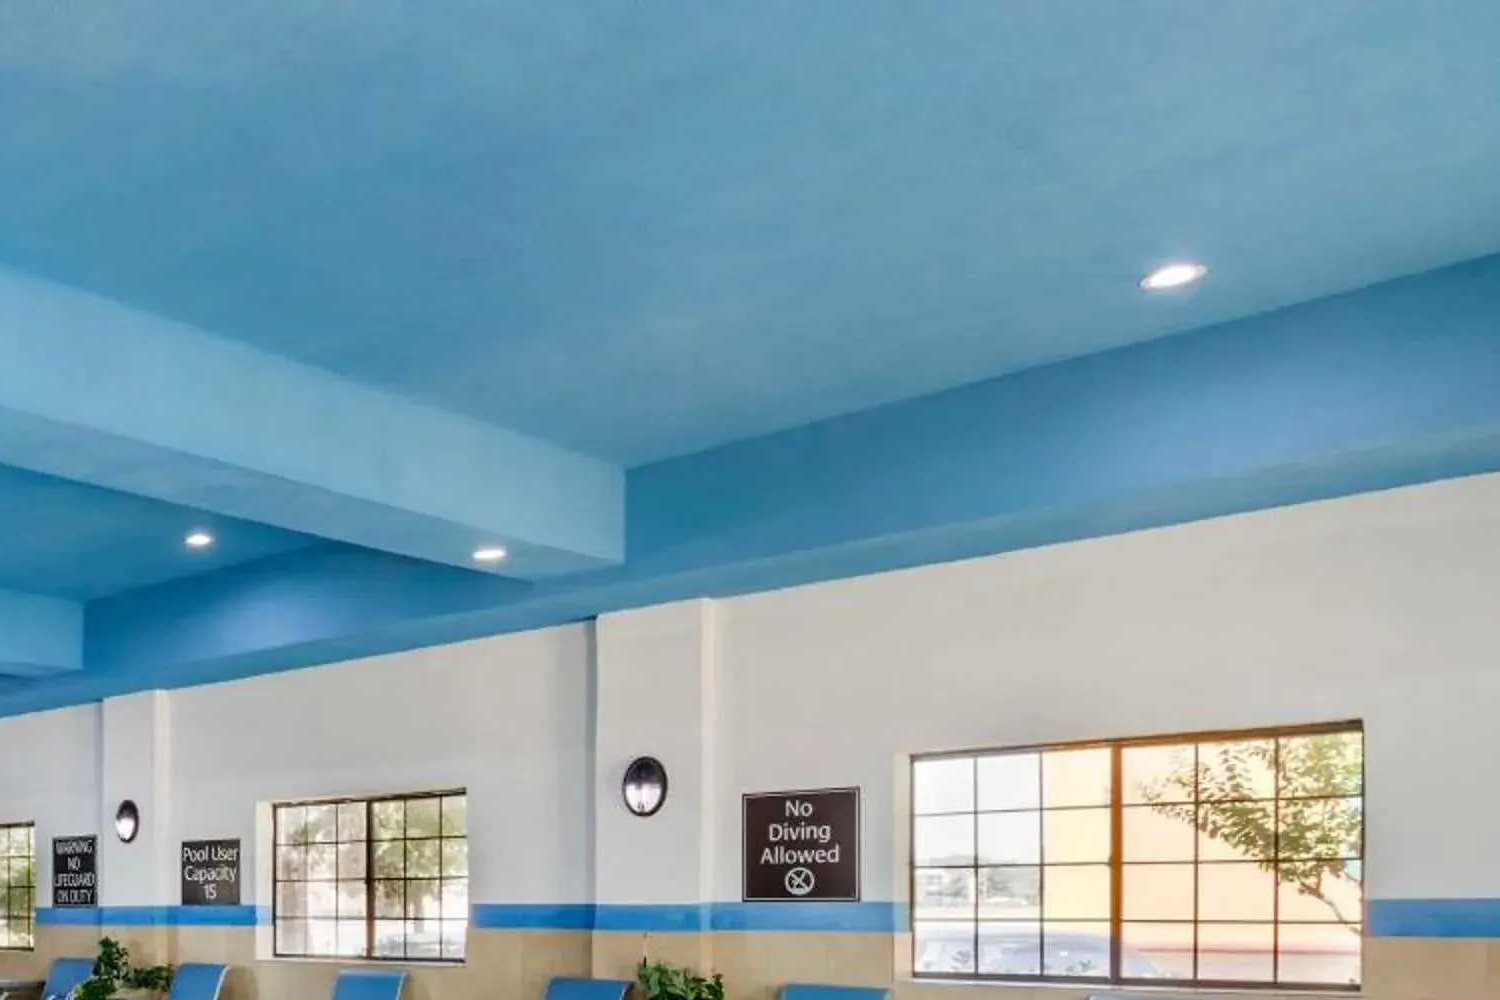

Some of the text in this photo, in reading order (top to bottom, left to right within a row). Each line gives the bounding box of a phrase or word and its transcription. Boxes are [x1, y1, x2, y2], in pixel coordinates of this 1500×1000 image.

[785, 800, 813, 816] No
[769, 822, 831, 843] Diving
[183, 847, 238, 862] Pool User
[760, 843, 840, 864] Allowed
[68, 857, 81, 870] NO
[55, 872, 95, 887] LIFEGUARD
[185, 865, 237, 882] Capacity
[57, 889, 92, 904] ON DUTY
[204, 883, 217, 900] 15
